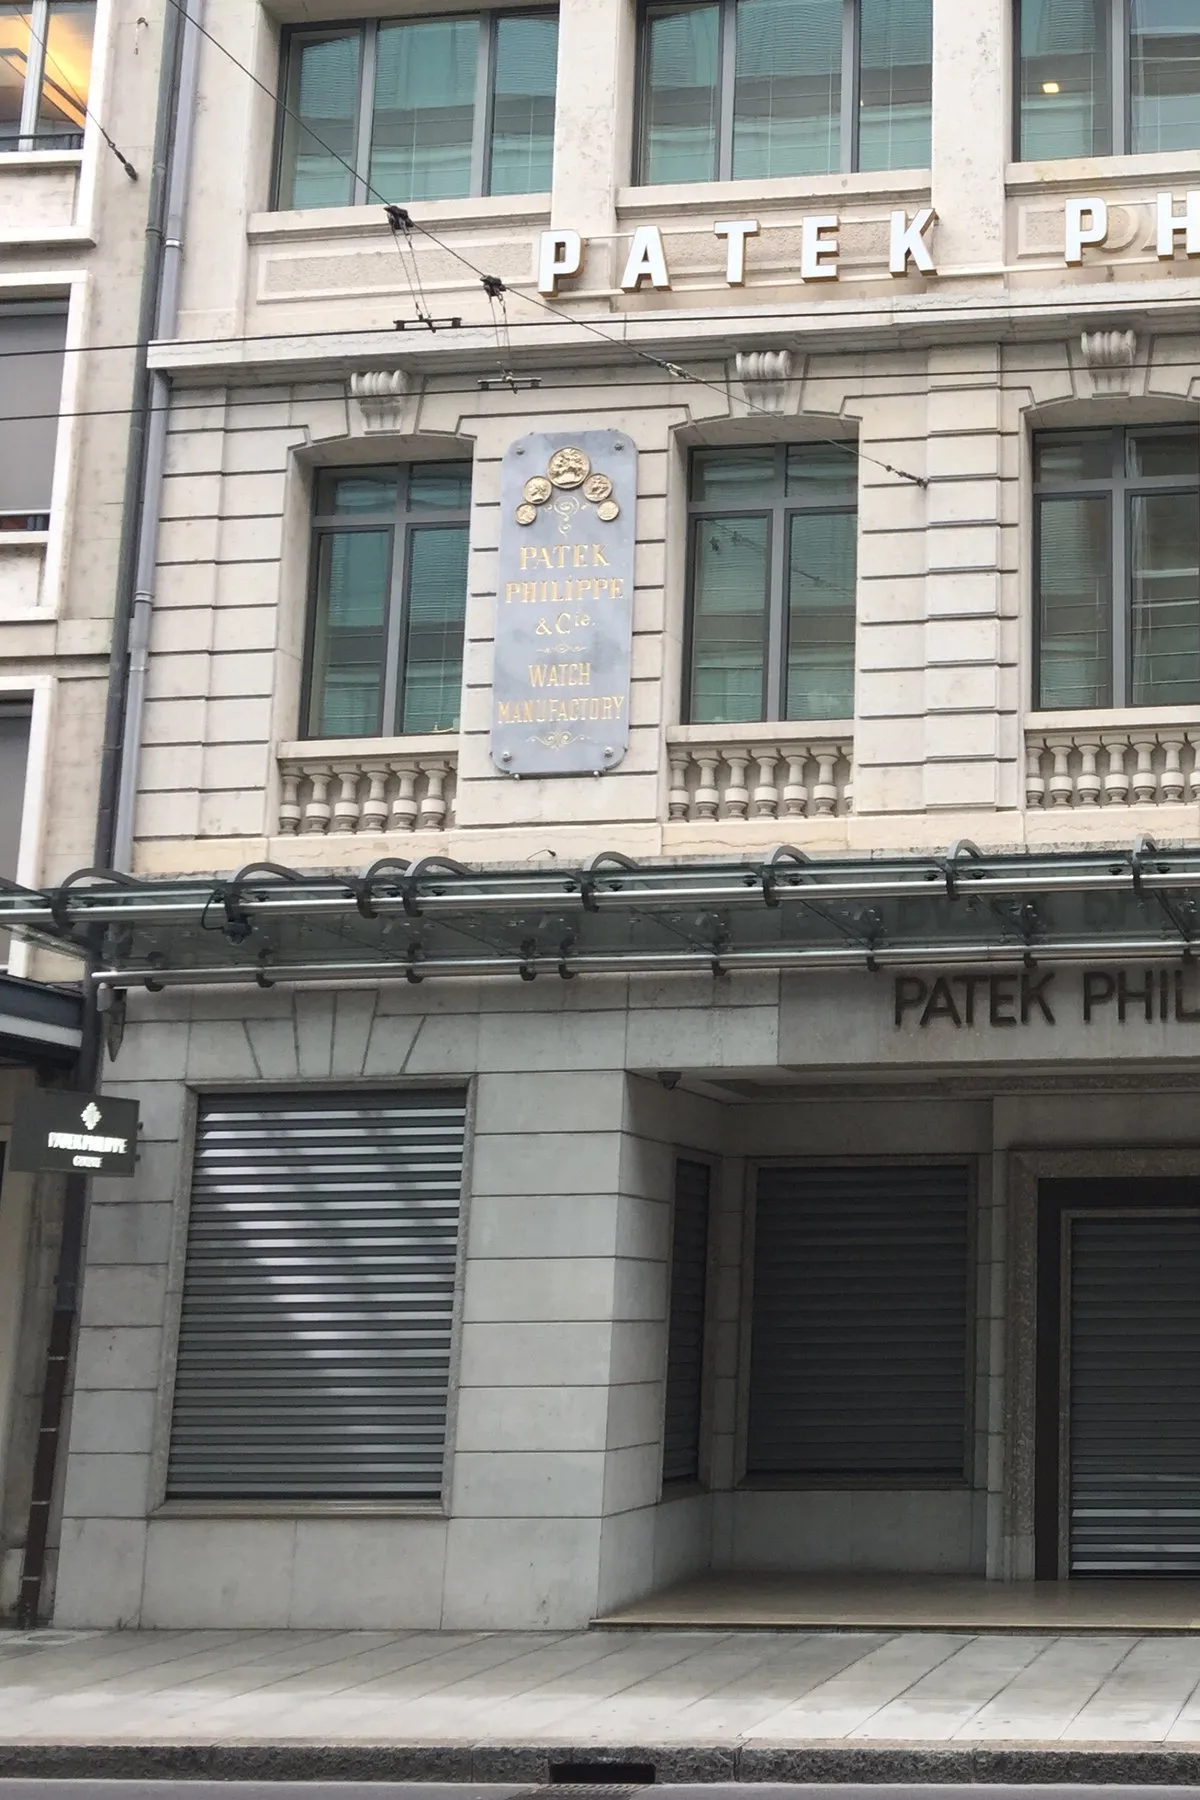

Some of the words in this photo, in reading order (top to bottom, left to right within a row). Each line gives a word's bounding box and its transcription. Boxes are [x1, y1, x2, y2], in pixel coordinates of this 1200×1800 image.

[538, 207, 939, 298] PATEK
[519, 544, 611, 571] PATEK
[505, 576, 624, 604] PHILIPPE
[527, 662, 591, 688] WATCH
[497, 695, 625, 724] MANUFACTORY
[894, 970, 1055, 1027] PATEK
